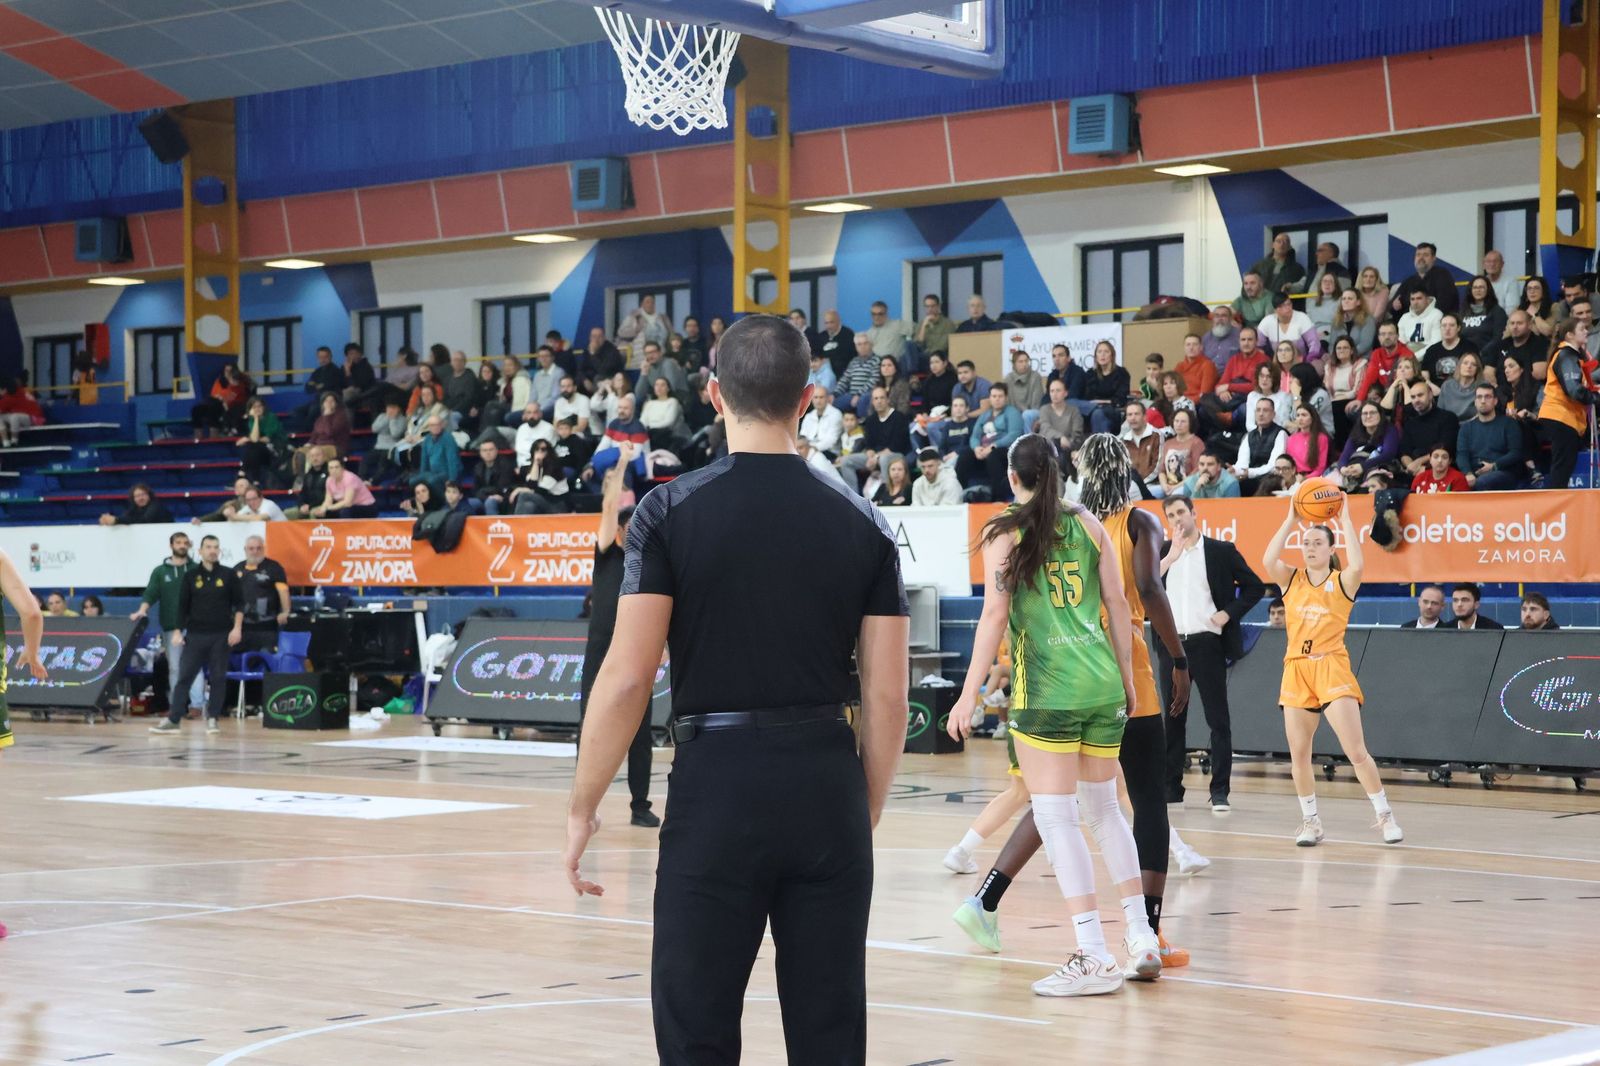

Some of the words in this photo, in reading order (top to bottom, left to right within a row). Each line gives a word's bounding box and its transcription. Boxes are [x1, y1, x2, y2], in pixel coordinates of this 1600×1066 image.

[1359, 515, 1484, 544] roletas
[1493, 512, 1566, 543] salud
[1478, 549, 1566, 563] ZAMORA
[341, 560, 418, 583] ZAMORA
[523, 558, 594, 582] ZAMOR
[1044, 561, 1084, 609] 55
[1301, 639, 1312, 655] 13
